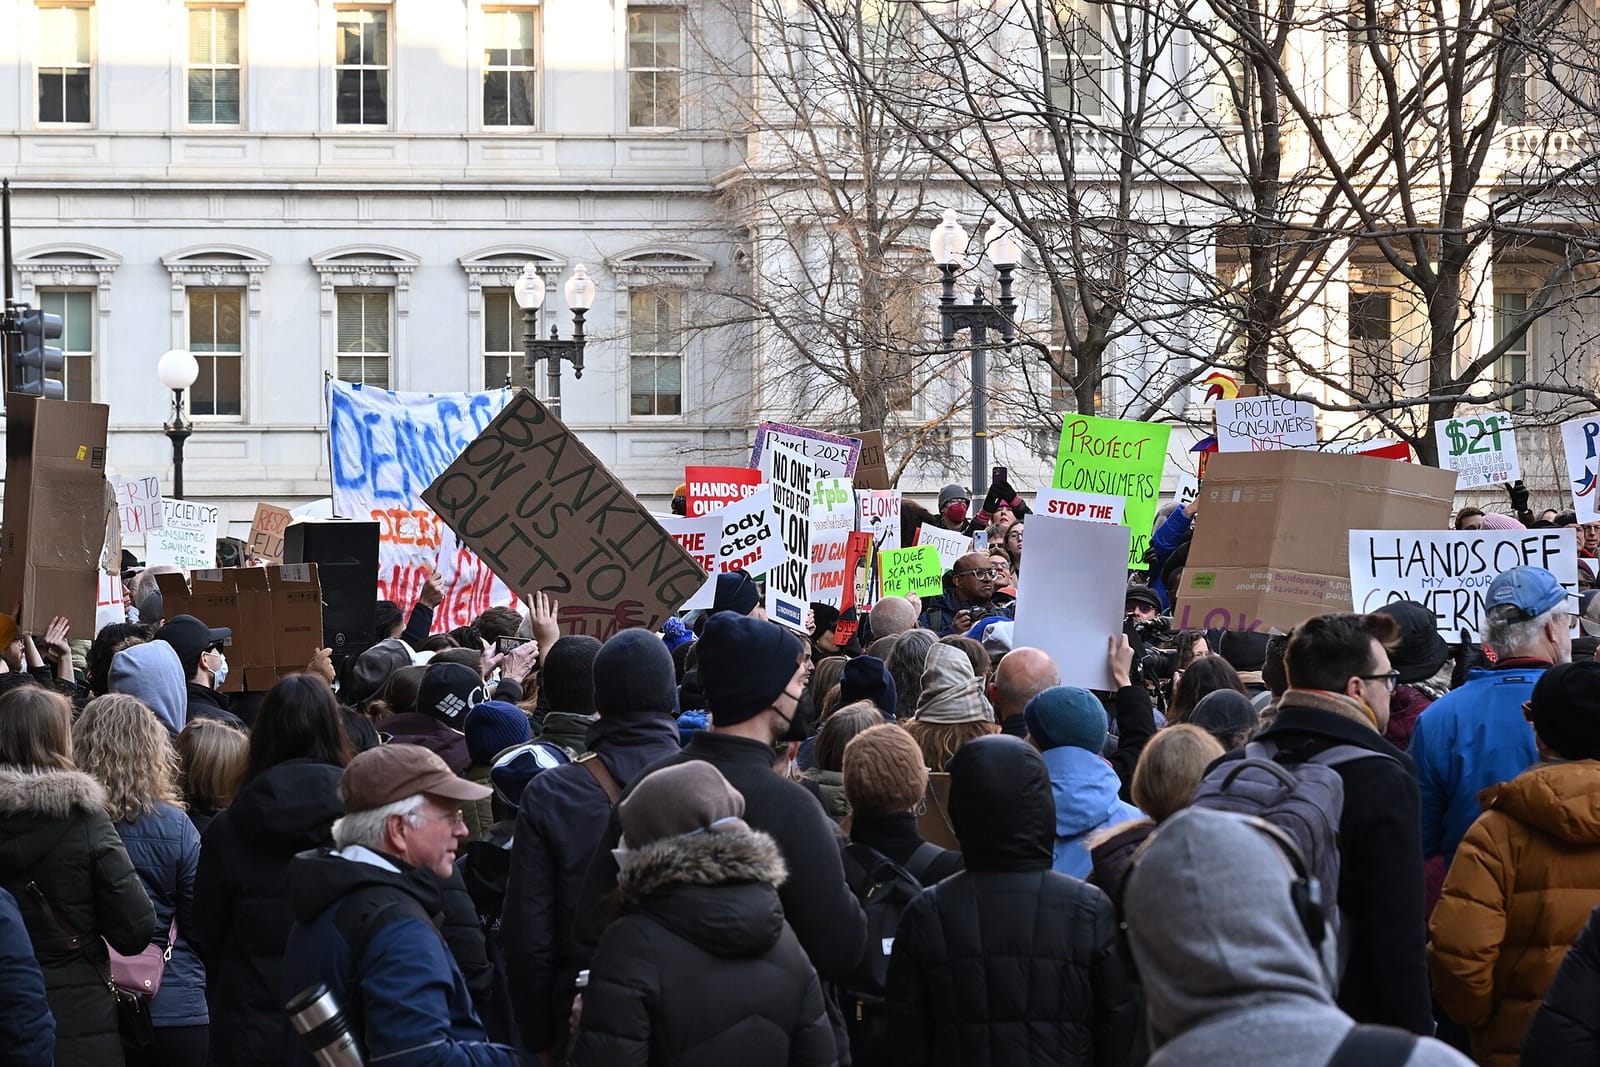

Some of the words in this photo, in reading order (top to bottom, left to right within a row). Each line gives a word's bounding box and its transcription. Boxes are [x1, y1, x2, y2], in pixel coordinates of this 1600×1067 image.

[1234, 399, 1299, 420] PROTECT
[1228, 416, 1313, 438] CONSUMERS
[1068, 419, 1151, 460] PROTECT
[1251, 434, 1285, 451] NOT
[814, 444, 849, 466] 2025
[858, 445, 880, 466] ECT
[1449, 452, 1504, 470] BILLION
[773, 449, 788, 484] NO
[790, 459, 812, 496] ONE
[1060, 458, 1154, 503] CONSUMERS
[1463, 476, 1480, 486] TO
[1484, 472, 1508, 483] YOU
[140, 476, 159, 499] TO
[689, 482, 739, 498] HANDS
[496, 394, 702, 609] BANKING
[773, 482, 795, 511] VOTED
[795, 491, 810, 518] FOR
[862, 497, 899, 518] ELON'S
[1048, 499, 1086, 517] STOP
[1089, 504, 1113, 520] THE
[463, 434, 527, 491] ON
[515, 479, 575, 539] US
[573, 536, 627, 601] TO
[721, 510, 765, 539] ody
[436, 472, 571, 594] QUIT?
[919, 531, 962, 558] PROTECT
[1369, 536, 1486, 579] HANDS
[1493, 534, 1561, 572] OFF
[770, 559, 808, 602] MUSK
[888, 563, 923, 580] SCAMS
[1250, 572, 1273, 580] brain
[1274, 573, 1327, 587] developing
[1421, 577, 1444, 589] MY
[1458, 574, 1493, 589] YOUR
[884, 579, 902, 593] THE
[1236, 582, 1256, 592] your
[1257, 584, 1271, 593] for
[1274, 585, 1308, 596] experts
[1311, 590, 1323, 599] by
[1326, 592, 1353, 602] gned
